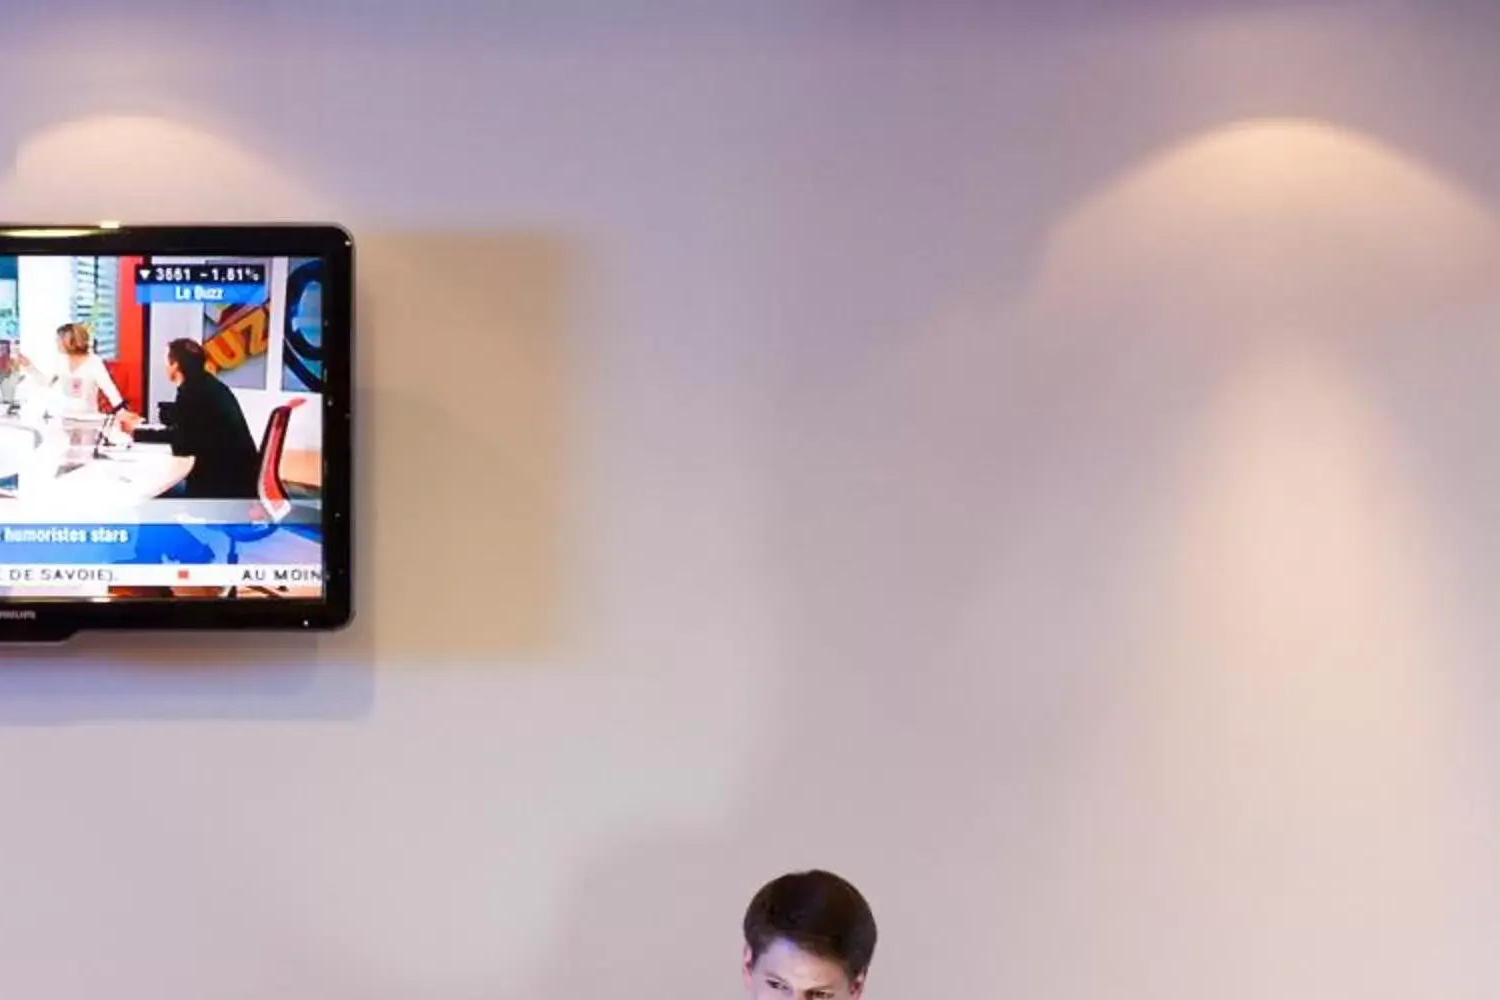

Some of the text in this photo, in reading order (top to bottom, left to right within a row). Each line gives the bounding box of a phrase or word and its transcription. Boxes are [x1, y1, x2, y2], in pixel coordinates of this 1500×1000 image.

[175, 286, 192, 300] Le
[5, 527, 88, 543] humoristes
[91, 528, 128, 543] stars
[9, 568, 35, 582] DE
[241, 569, 266, 581] AU
